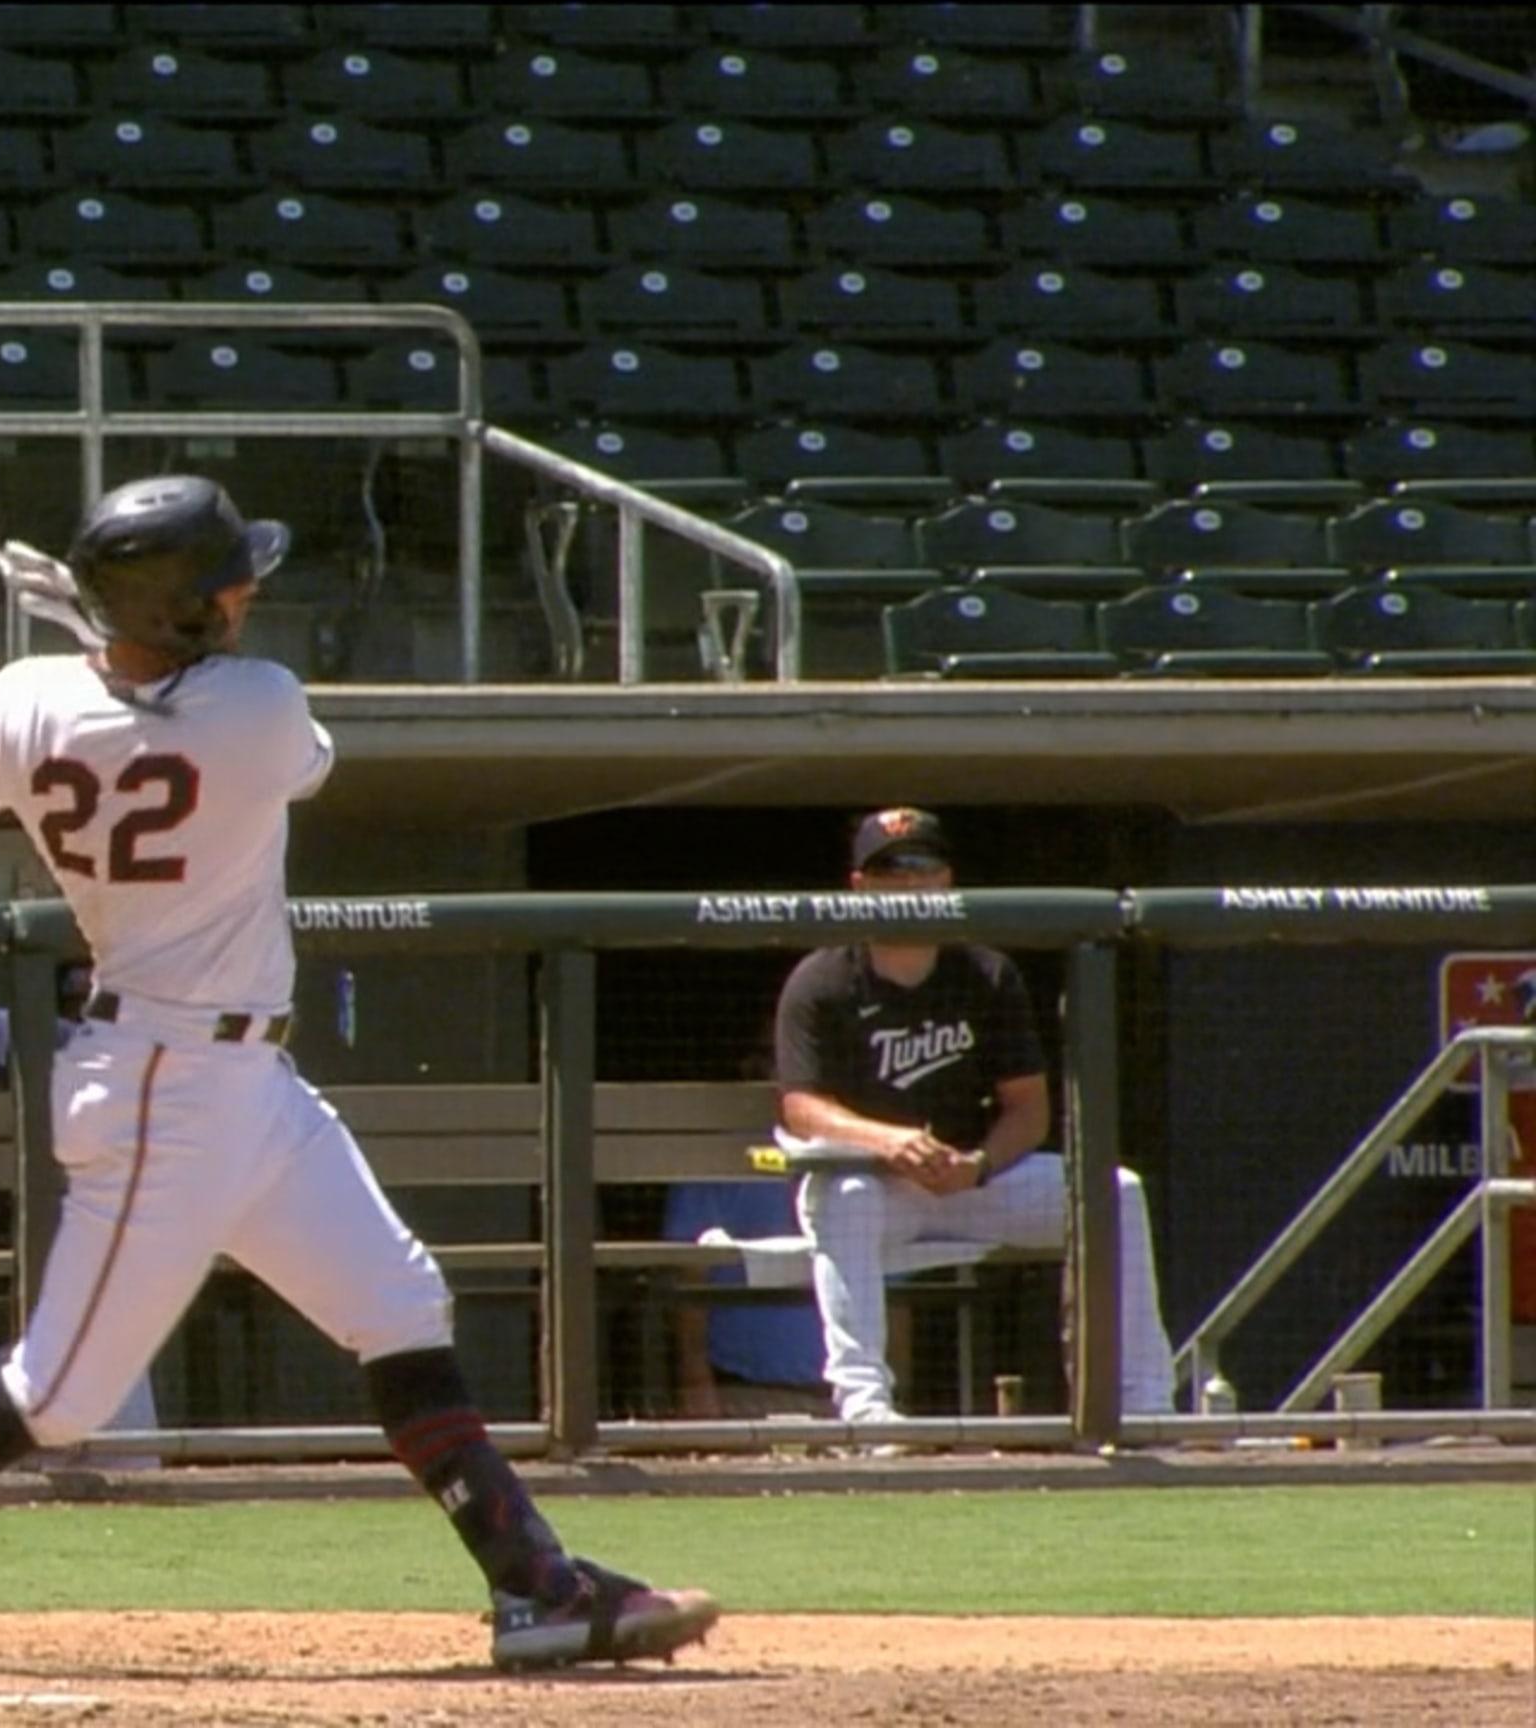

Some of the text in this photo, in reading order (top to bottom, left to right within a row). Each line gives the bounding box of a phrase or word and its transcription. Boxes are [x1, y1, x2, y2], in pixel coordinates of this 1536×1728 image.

[30, 752, 200, 883] 22
[697, 893, 968, 922] ASHLEY FURNITURE
[1221, 886, 1491, 912] ASHLEY FURNITURE
[286, 901, 432, 929] URNITURE
[870, 1019, 975, 1080] Twins
